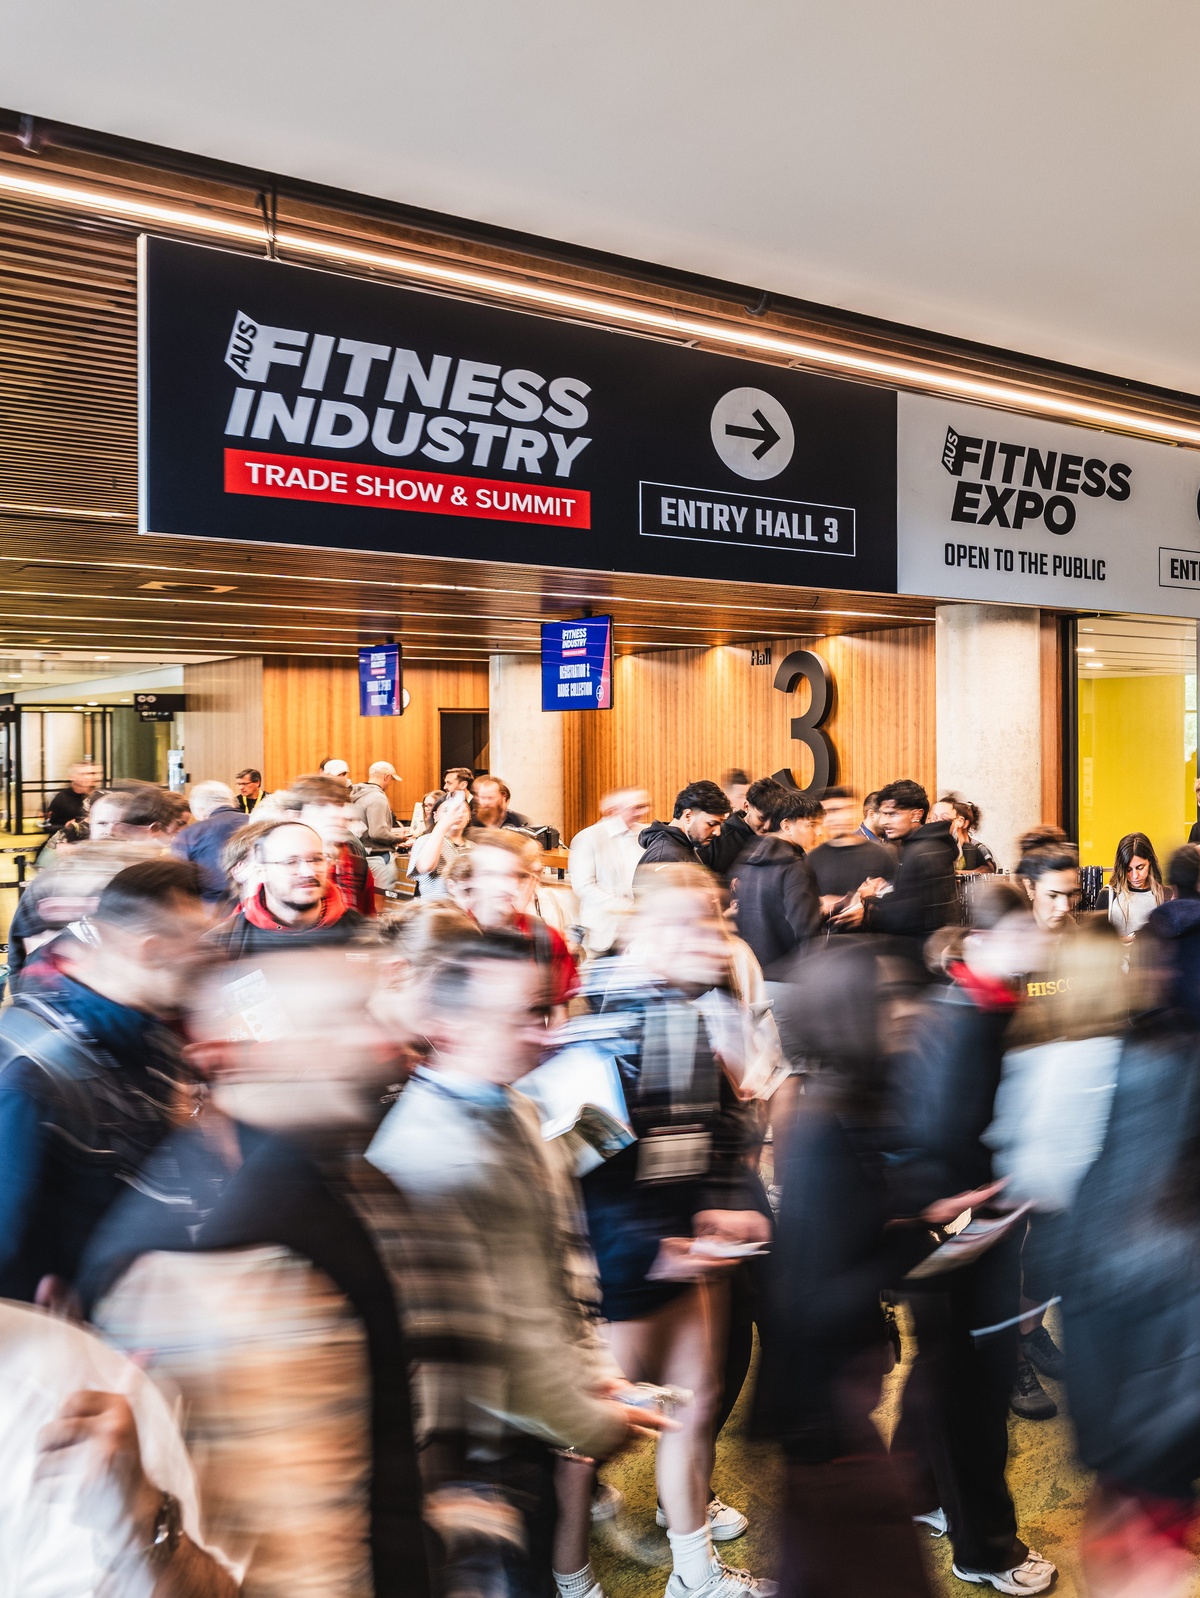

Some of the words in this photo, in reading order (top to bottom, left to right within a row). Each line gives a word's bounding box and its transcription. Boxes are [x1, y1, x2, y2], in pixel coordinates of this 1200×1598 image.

[231, 319, 258, 375] AUS
[251, 324, 592, 429] FITNESS
[224, 387, 592, 478] INDUSTRY
[943, 431, 960, 472] AUS
[244, 461, 349, 492] TRADE
[354, 474, 444, 505] SHOW
[450, 484, 470, 508] &
[474, 487, 577, 518] SUMMIT
[954, 435, 1132, 501] FITNESS
[660, 497, 748, 535] ENTRY
[755, 508, 818, 541] HALL
[823, 517, 839, 544] 3
[950, 480, 1077, 536] EXPO
[944, 542, 989, 569] OPEN
[994, 548, 1014, 573] TO
[1018, 551, 1048, 576] THE
[1052, 554, 1106, 581] PUBLIC
[751, 648, 771, 666] Hall
[771, 650, 835, 800] 3
